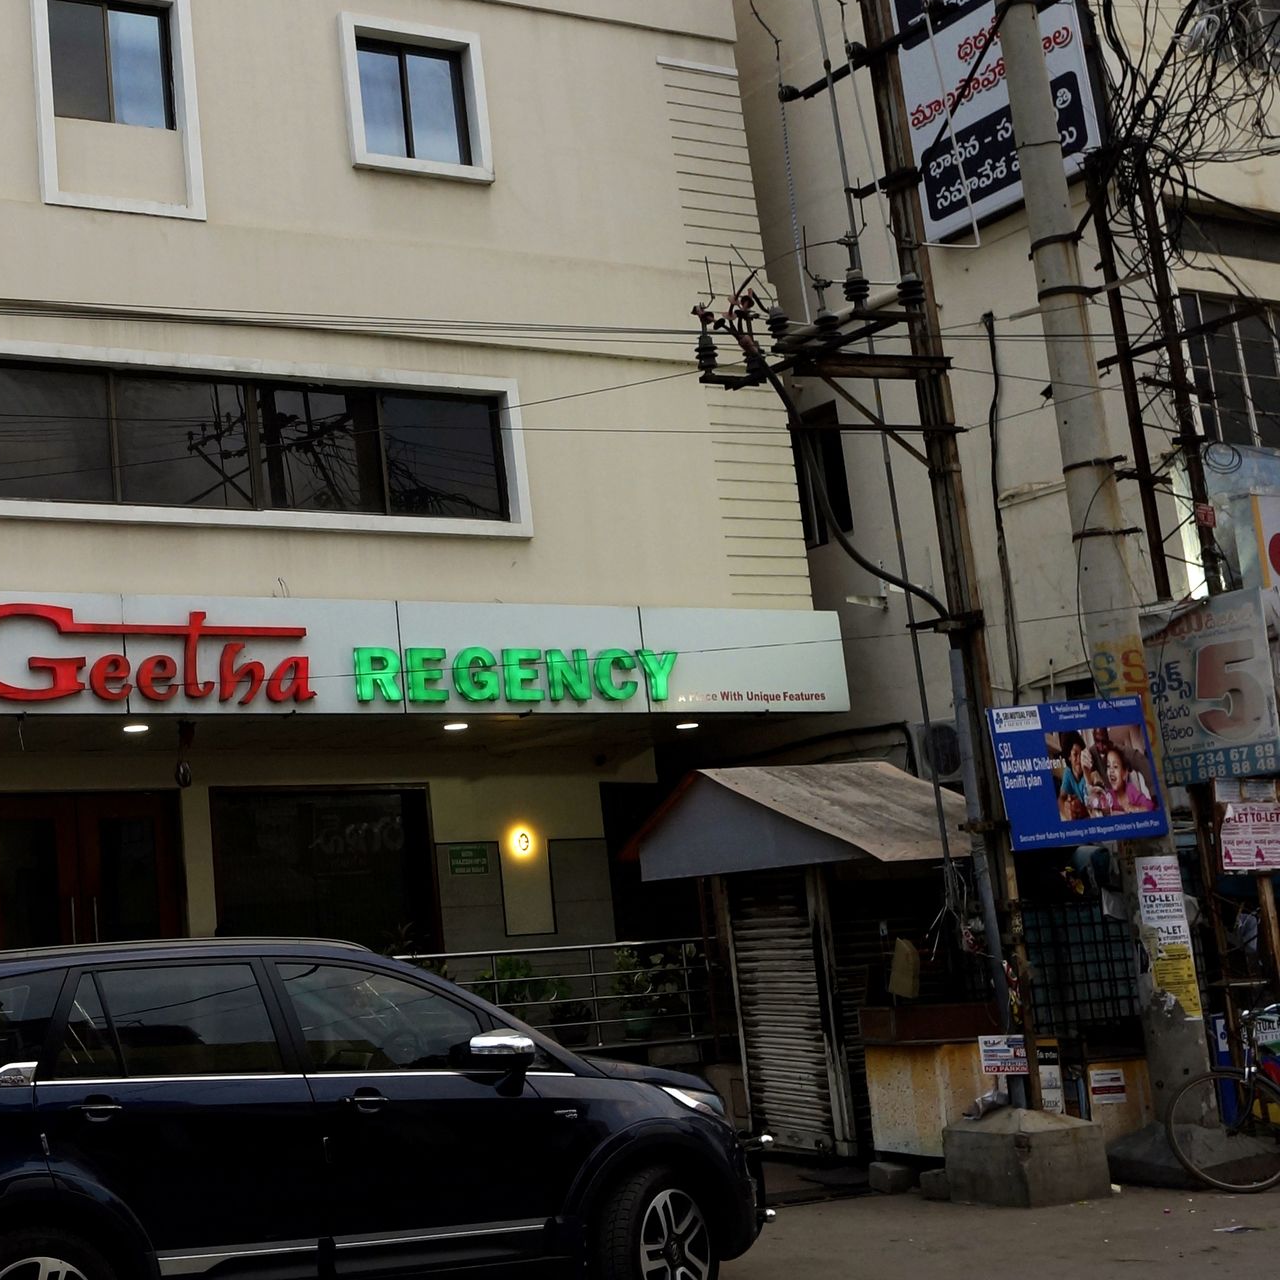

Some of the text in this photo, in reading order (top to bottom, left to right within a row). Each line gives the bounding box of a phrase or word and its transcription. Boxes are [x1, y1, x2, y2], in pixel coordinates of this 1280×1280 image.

[353, 646, 680, 704] REGENCY
[720, 691, 744, 702] With
[746, 691, 782, 704] Unique
[783, 691, 826, 702] Features
[1196, 639, 1267, 741] 5
[998, 742, 1013, 759] SBI
[1196, 750, 1225, 767] 234
[1230, 746, 1249, 762] 67
[985, 1065, 999, 1073] NO
